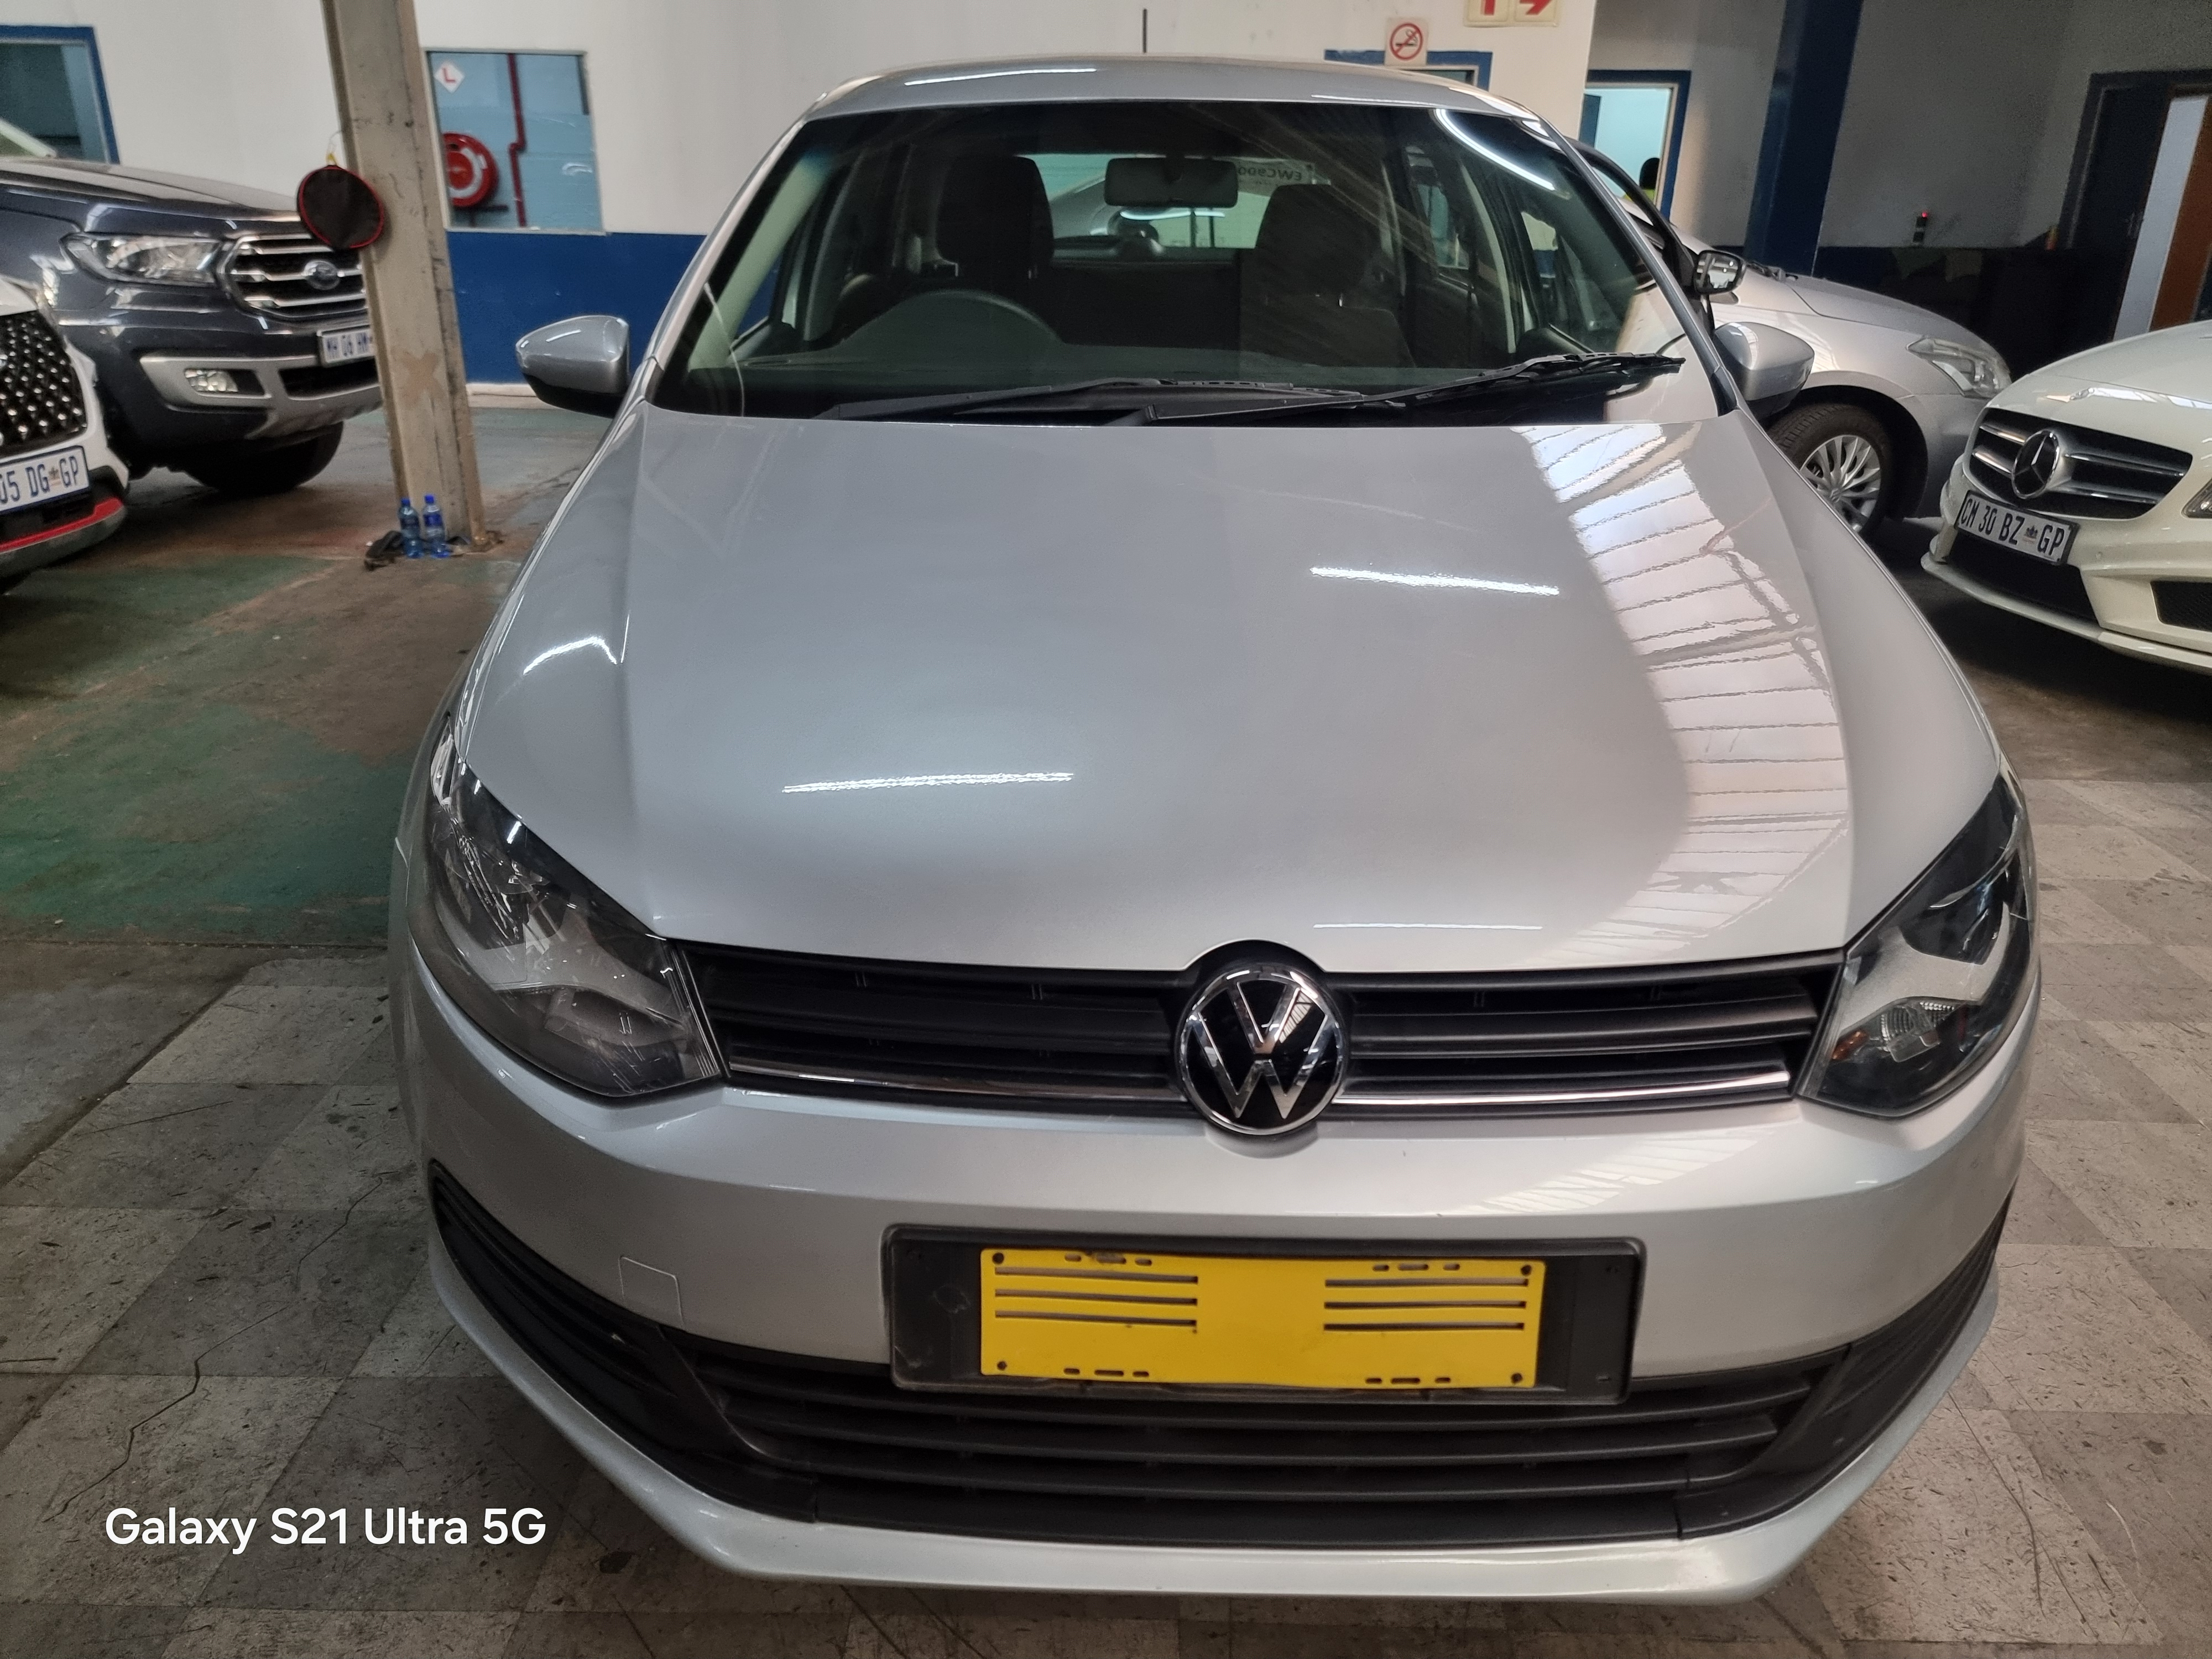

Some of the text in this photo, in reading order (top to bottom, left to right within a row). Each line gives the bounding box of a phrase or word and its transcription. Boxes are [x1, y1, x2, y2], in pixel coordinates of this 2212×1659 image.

[442, 67, 456, 84] L
[25, 464, 50, 497] DG
[59, 456, 78, 488] GP
[1961, 498, 2064, 555] CM 30 BZ GP
